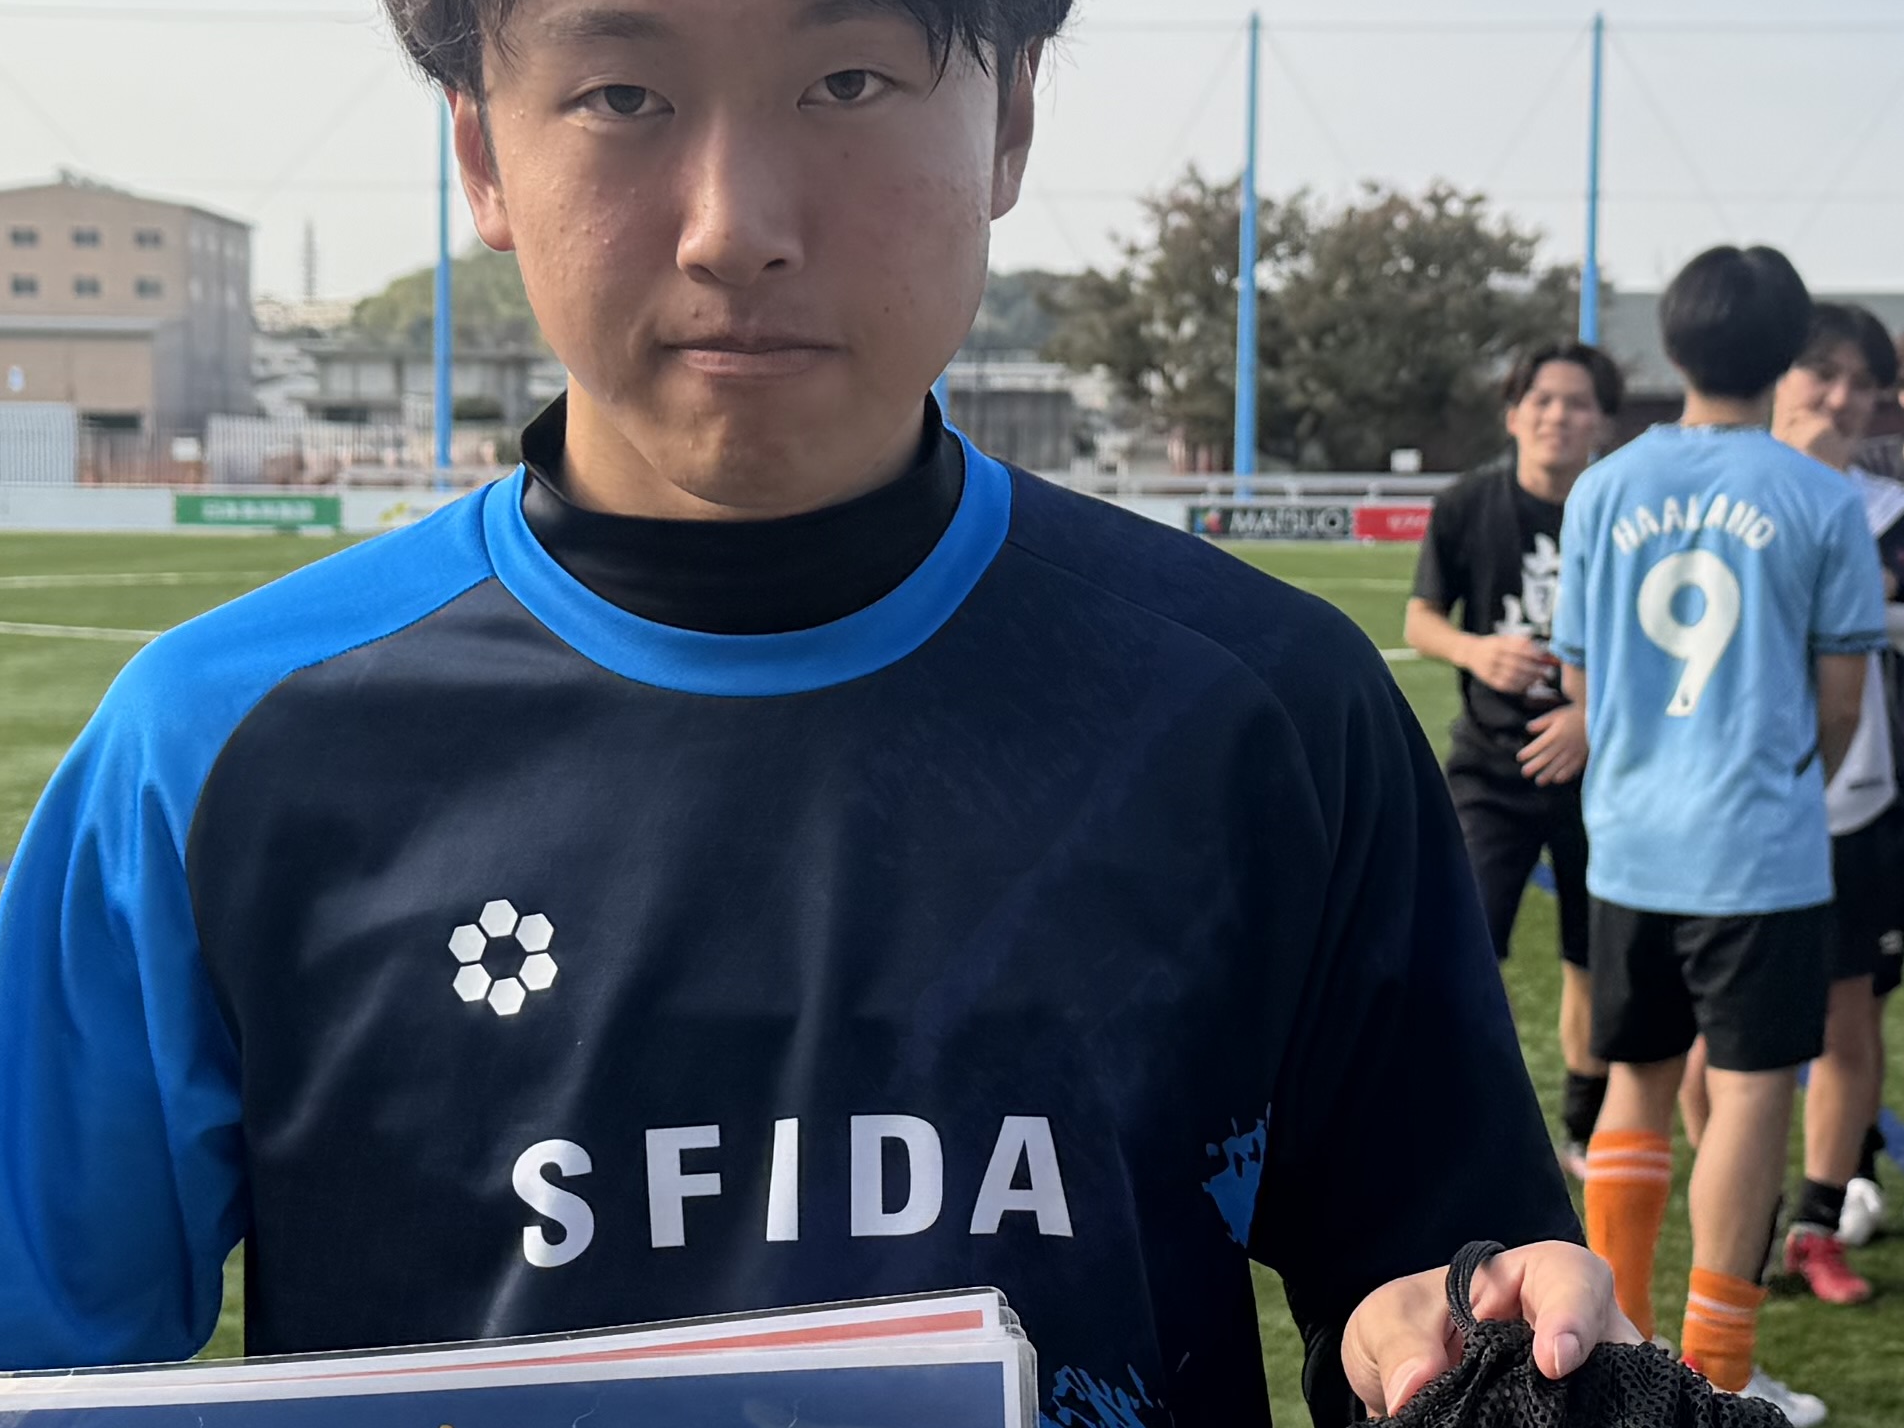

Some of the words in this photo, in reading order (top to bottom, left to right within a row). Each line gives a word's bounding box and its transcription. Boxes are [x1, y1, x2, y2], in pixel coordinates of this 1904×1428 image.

[1611, 492, 1777, 555] HAALAND
[1637, 548, 1741, 717] 9
[512, 1114, 1073, 1267] SFIDA
